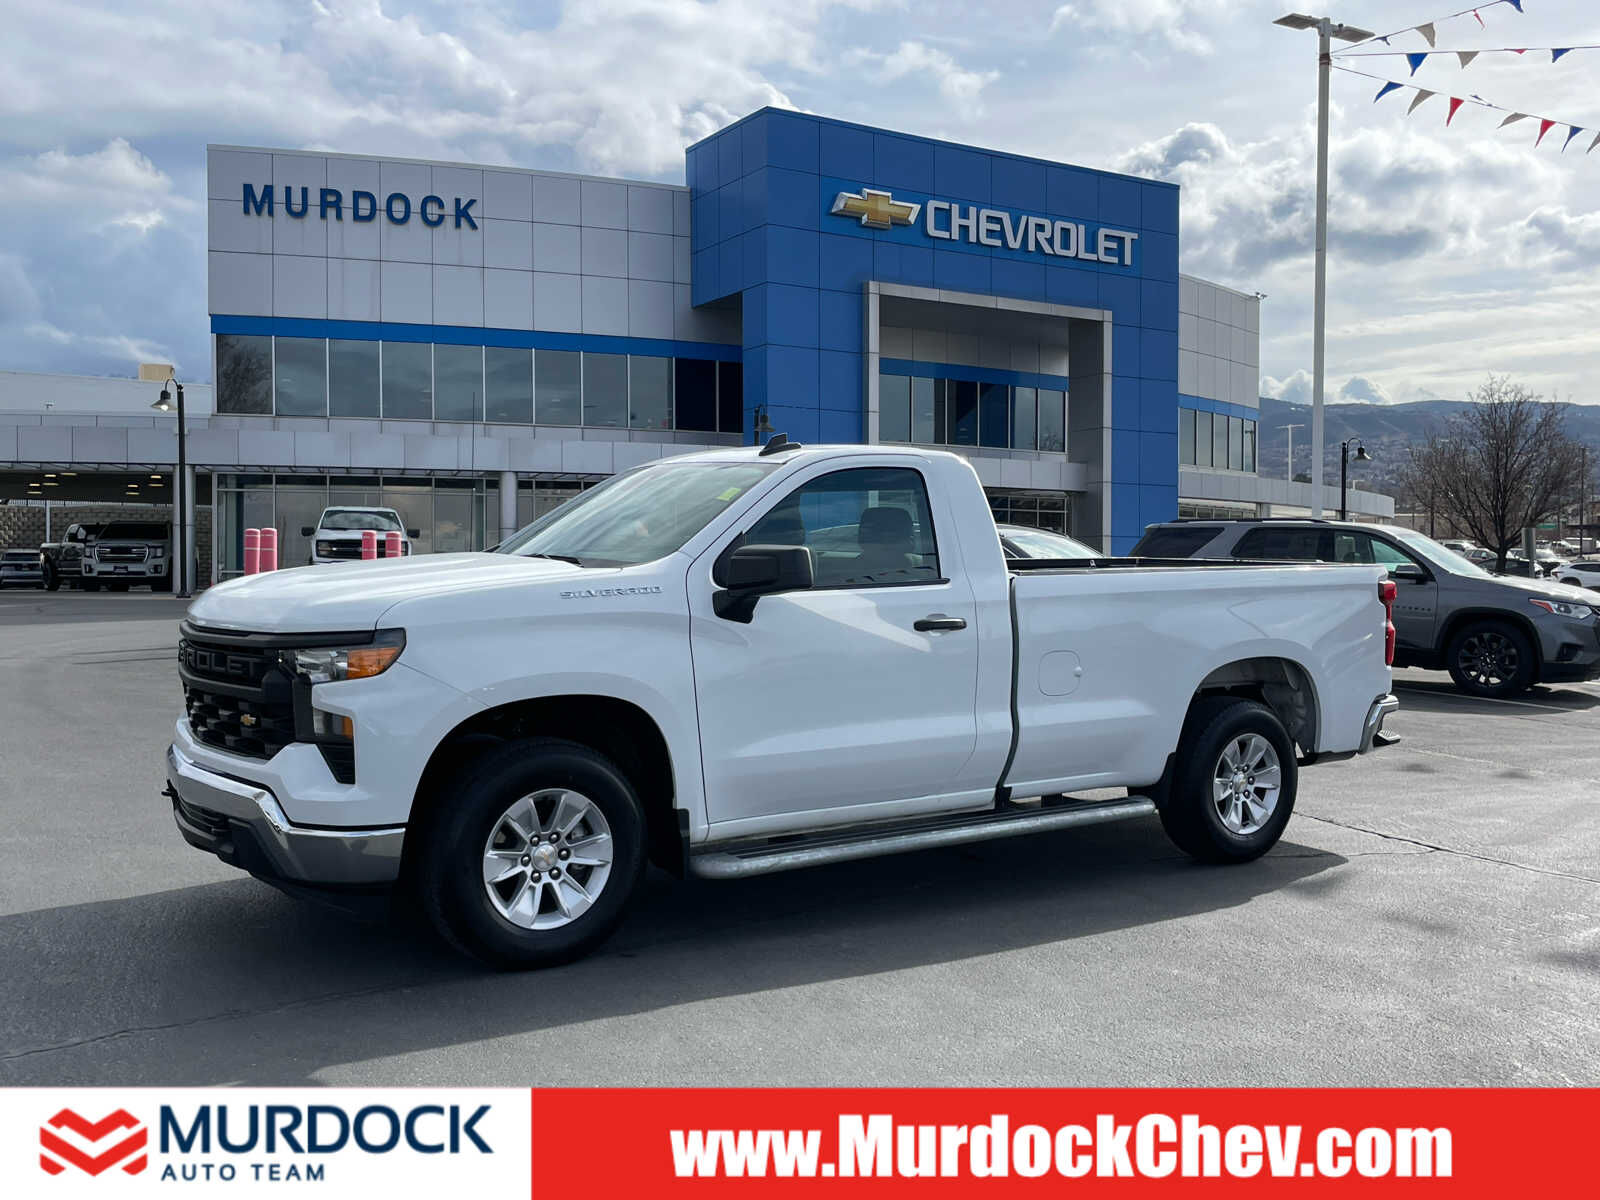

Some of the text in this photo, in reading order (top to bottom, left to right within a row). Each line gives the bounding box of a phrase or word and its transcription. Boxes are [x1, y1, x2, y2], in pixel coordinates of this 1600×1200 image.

[242, 183, 480, 230] MURDOCK
[926, 199, 1138, 266] CHEVROLET
[559, 585, 663, 600] SILVERADO
